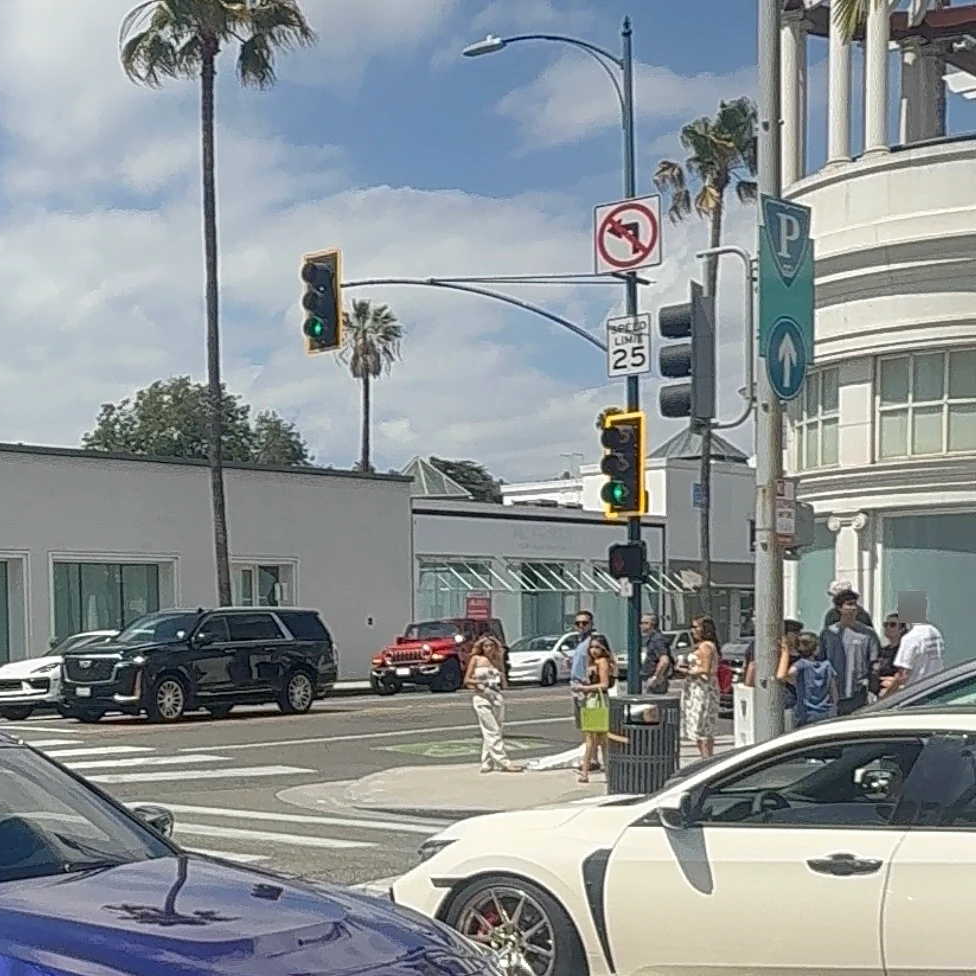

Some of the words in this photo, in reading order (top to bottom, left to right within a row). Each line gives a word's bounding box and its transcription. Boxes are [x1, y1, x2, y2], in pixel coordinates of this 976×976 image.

[776, 212, 800, 258] P
[610, 321, 647, 335] SPEED
[614, 334, 644, 346] LIMIT
[612, 345, 646, 370] 25
